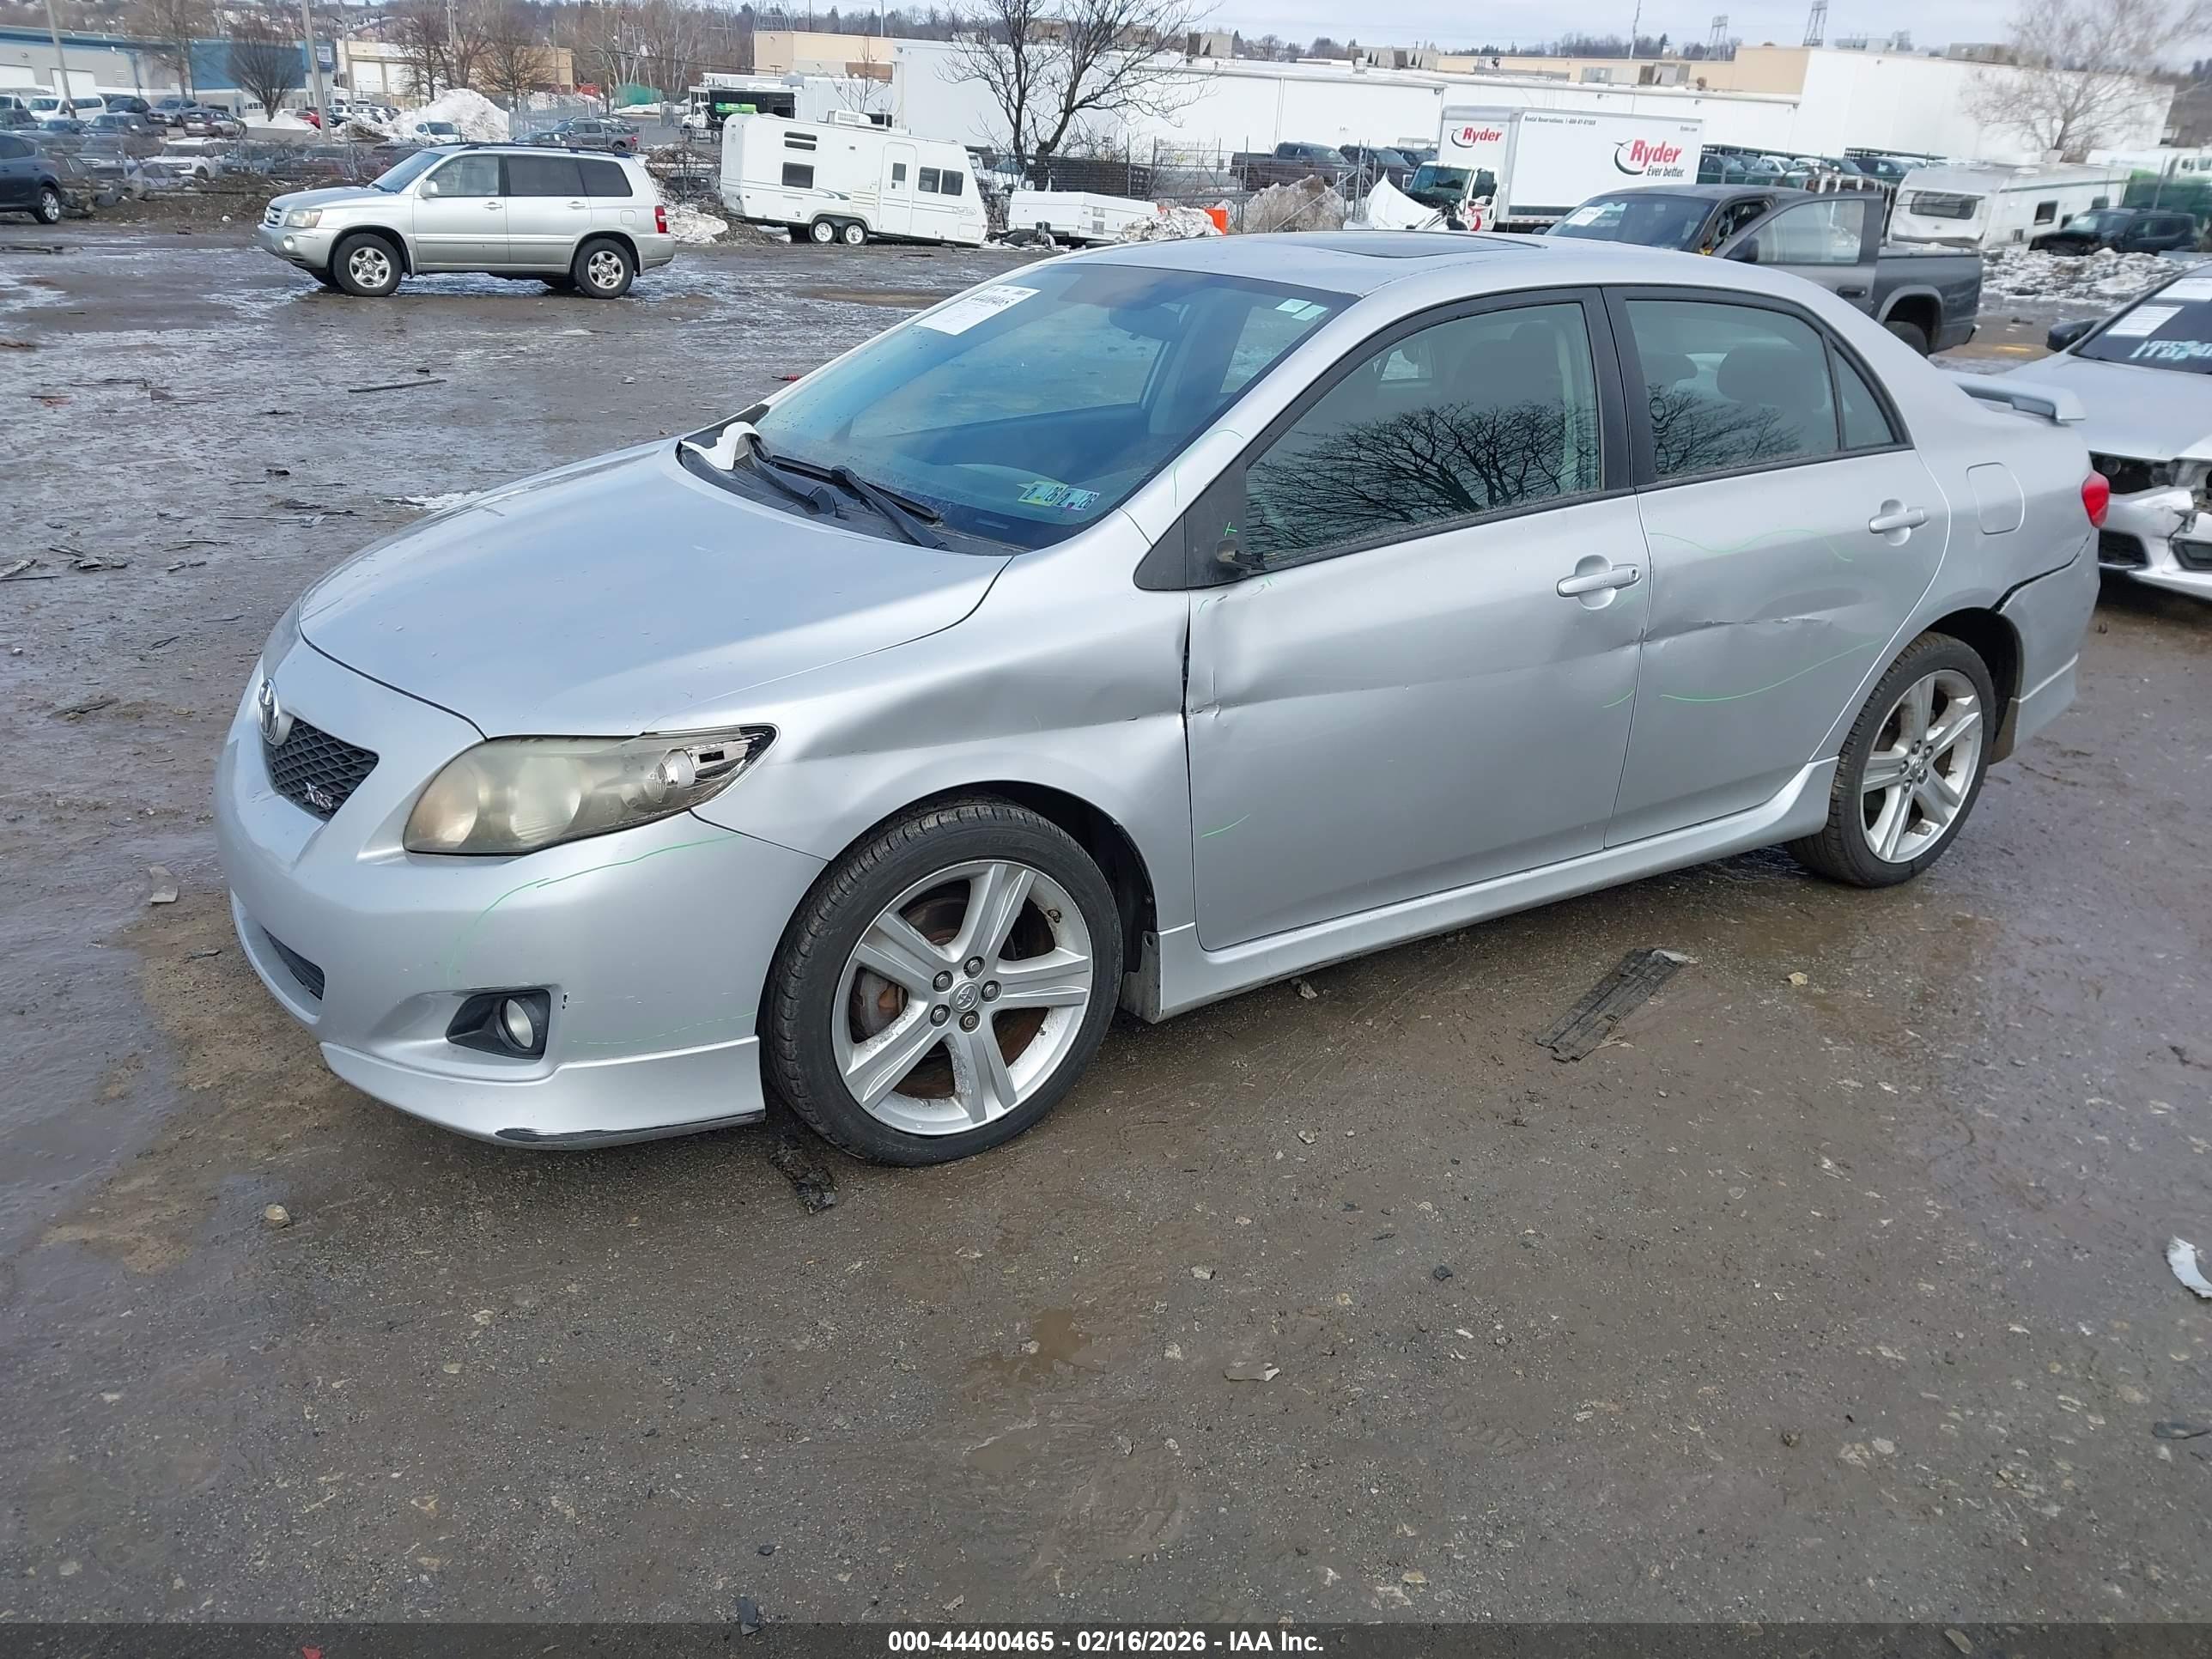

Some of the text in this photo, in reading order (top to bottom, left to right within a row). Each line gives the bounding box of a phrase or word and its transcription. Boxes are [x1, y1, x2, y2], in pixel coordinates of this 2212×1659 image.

[1462, 126, 1503, 144] Ryder
[1630, 139, 1683, 167] Ryder
[1646, 166, 1663, 177] Ever
[305, 781, 333, 810] XRS
